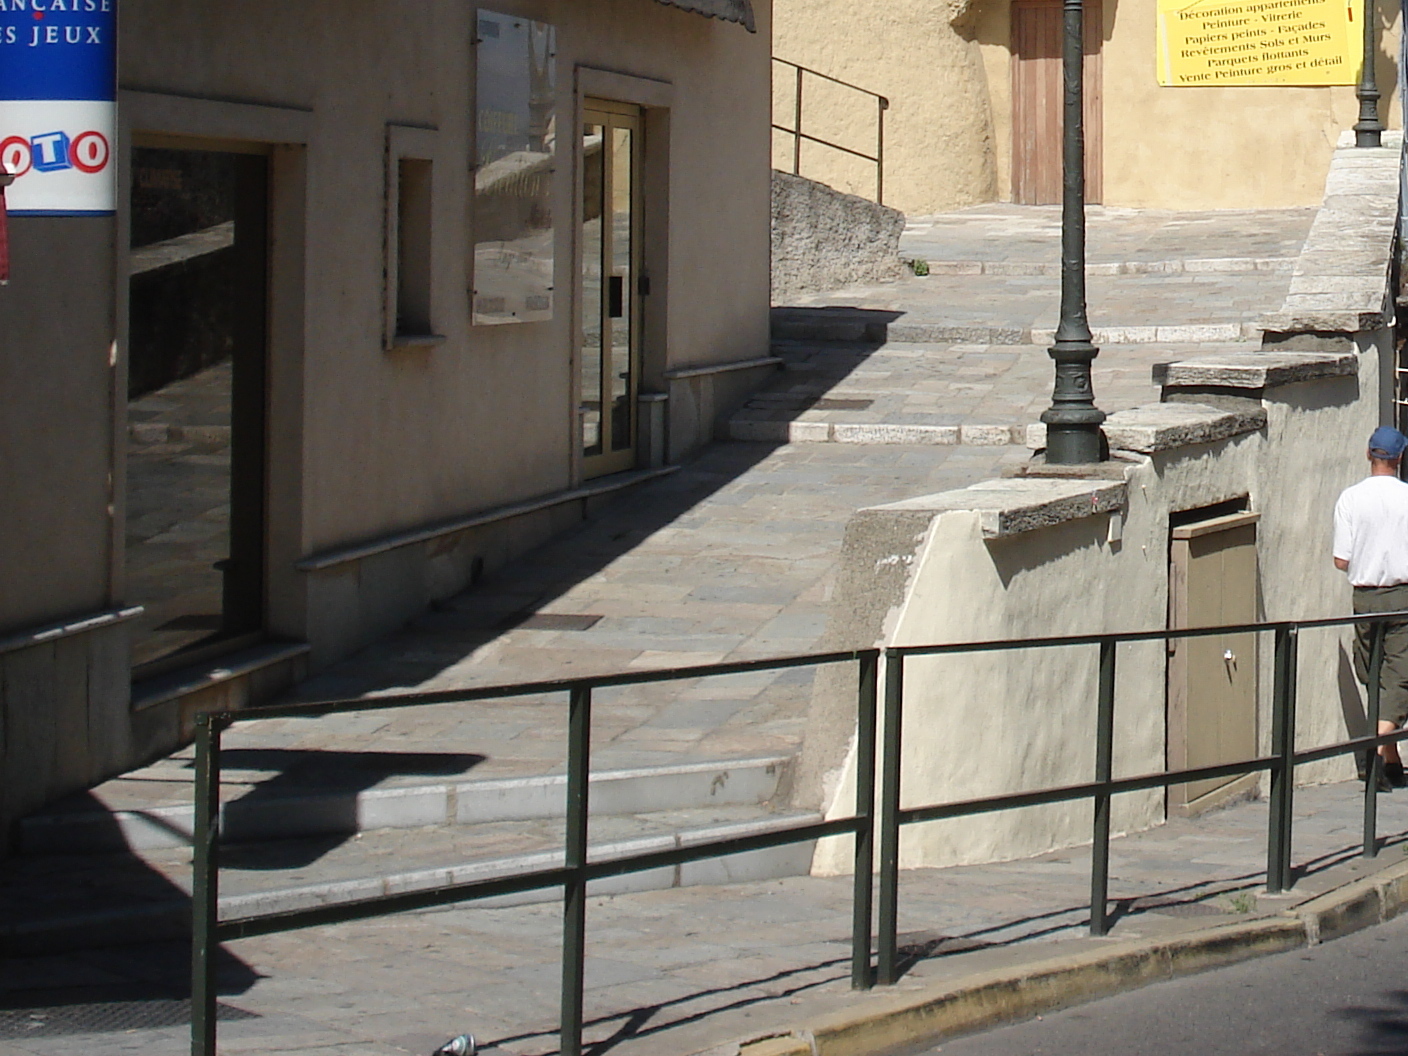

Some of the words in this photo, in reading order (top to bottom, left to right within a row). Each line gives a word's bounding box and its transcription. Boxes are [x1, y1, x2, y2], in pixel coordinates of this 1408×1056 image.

[1179, 5, 1243, 21] Décoration
[1202, 16, 1250, 30] Peinture
[1261, 10, 1303, 24] Vitrerie
[0, 25, 16, 45] S
[28, 25, 101, 47] JEUX
[1185, 33, 1228, 46] Papiers
[1231, 28, 1267, 41] peints
[1278, 21, 1326, 35] Façades
[1181, 41, 1256, 58] Revêtements
[1260, 37, 1285, 49] Sols
[1288, 35, 1299, 45] et
[1302, 32, 1331, 44] Murs
[1208, 54, 1259, 68] Parquets
[1262, 47, 1309, 61] flottants
[1179, 72, 1211, 83] Vente
[1215, 66, 1262, 80] Peinture
[1267, 63, 1292, 75] gros
[1295, 60, 1307, 70] et
[1310, 56, 1342, 68] détail
